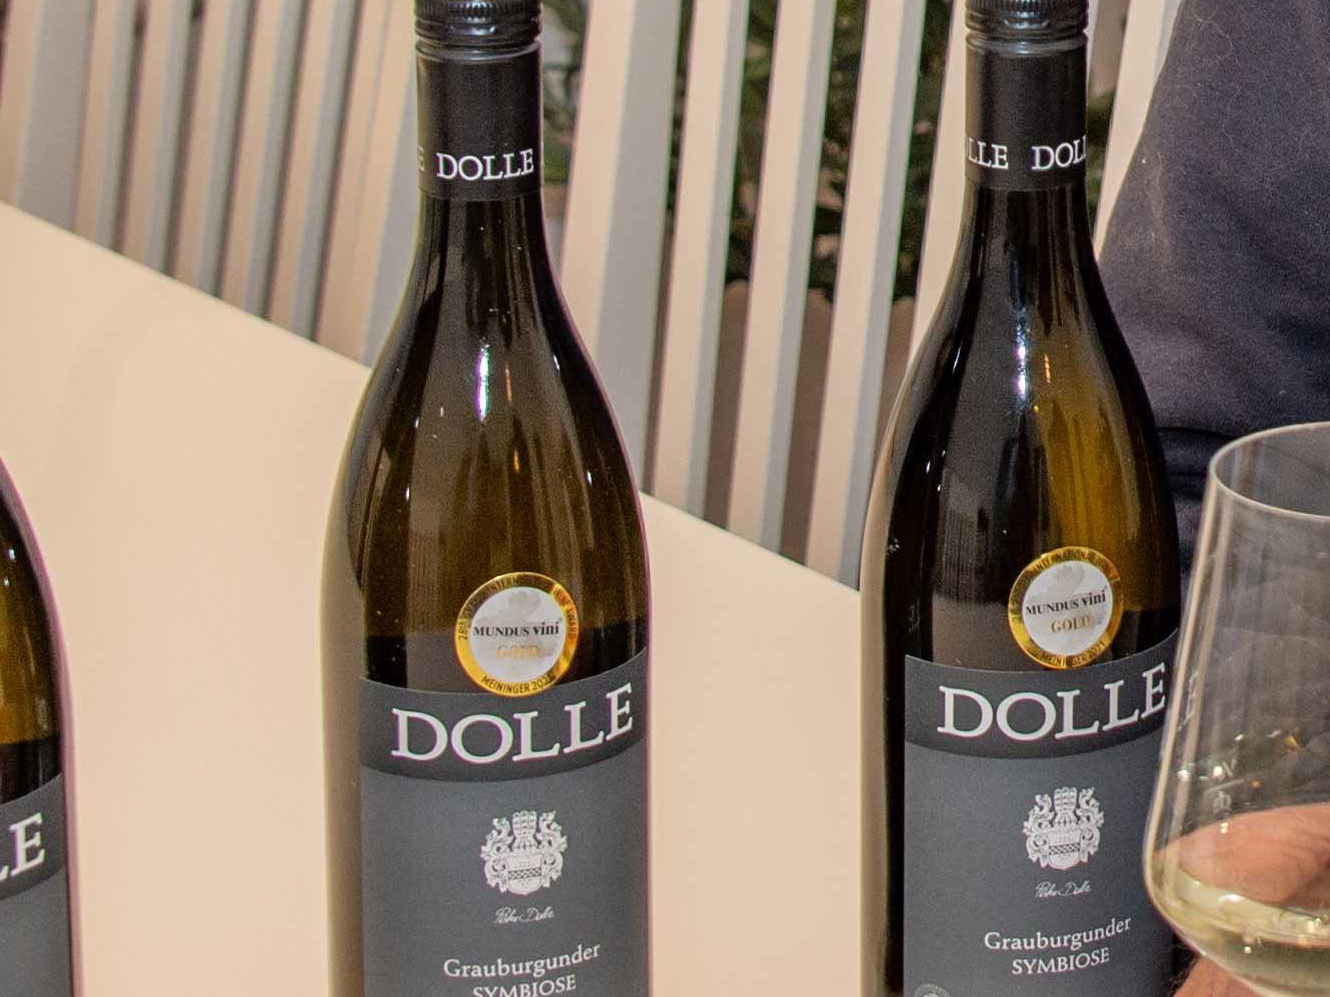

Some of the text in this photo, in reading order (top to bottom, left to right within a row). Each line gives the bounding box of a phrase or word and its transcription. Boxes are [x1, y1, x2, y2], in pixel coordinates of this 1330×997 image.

[436, 148, 534, 181] DOLLE
[968, 137, 1009, 170] LLE
[1025, 589, 1106, 616] MUNDUS vini
[473, 621, 559, 637] MUNDUS vini
[1051, 616, 1093, 635] GOLD
[481, 675, 530, 694] MEININGER
[937, 662, 1166, 741] DOLLE
[391, 682, 633, 764] DOLLE
[984, 916, 1131, 951] Grauburgunder
[443, 944, 600, 979] Grauburgunder
[1011, 947, 1110, 975] SYMBIOSE
[473, 974, 577, 997] SYMBIOSE
